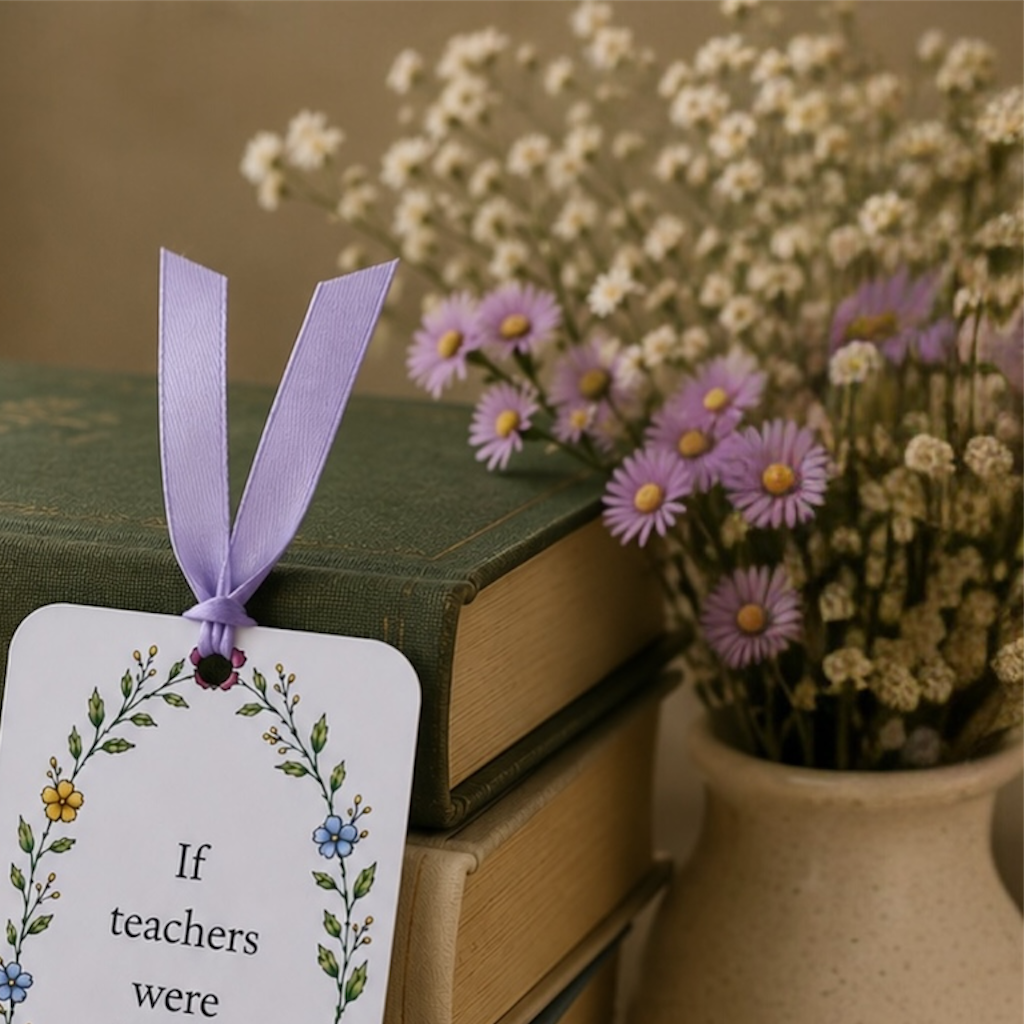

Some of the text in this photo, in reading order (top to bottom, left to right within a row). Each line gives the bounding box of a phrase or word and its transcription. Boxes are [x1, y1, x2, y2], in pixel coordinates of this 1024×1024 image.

[175, 842, 212, 881] If
[110, 906, 260, 956] teachers
[131, 981, 220, 1018] were
